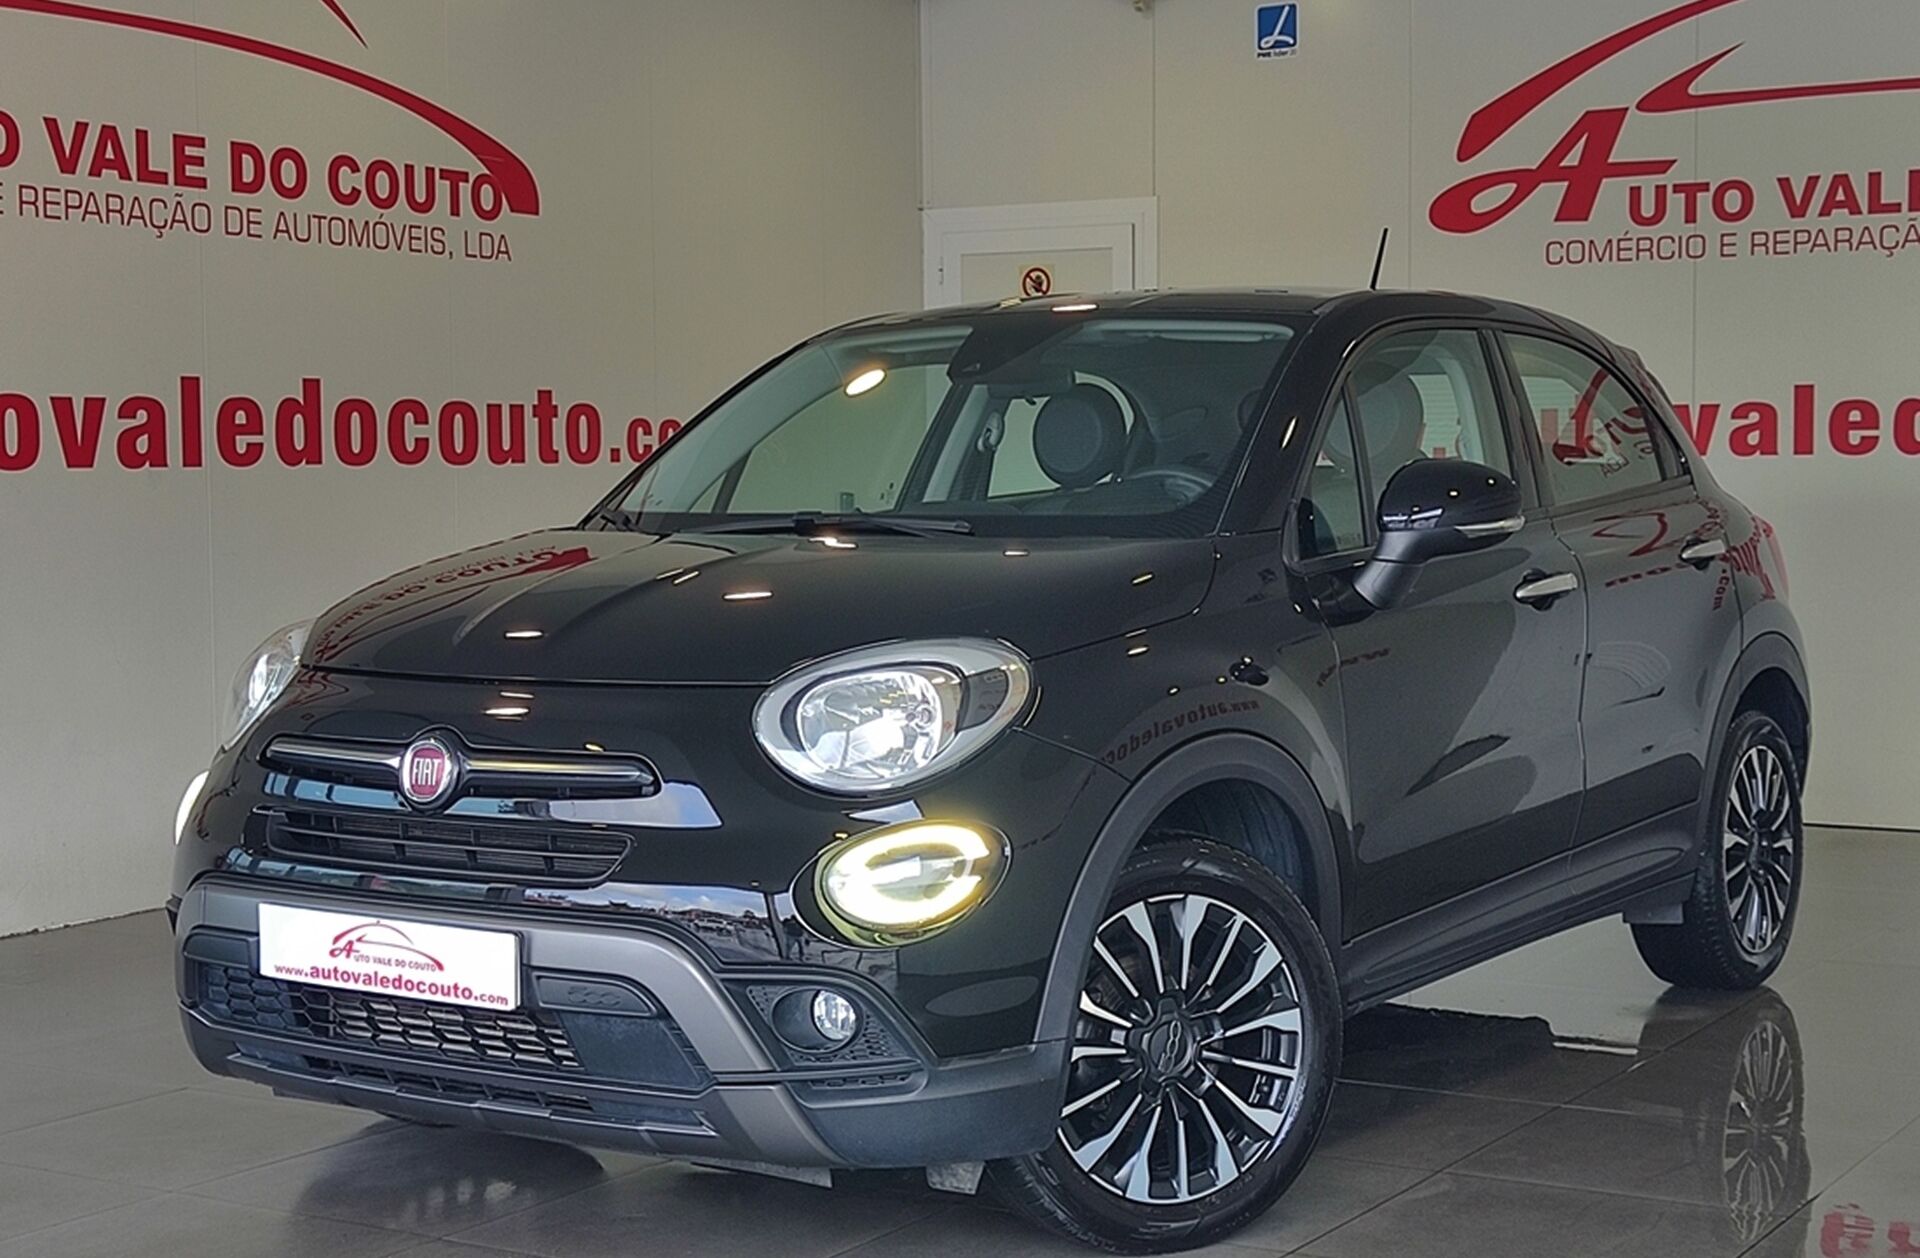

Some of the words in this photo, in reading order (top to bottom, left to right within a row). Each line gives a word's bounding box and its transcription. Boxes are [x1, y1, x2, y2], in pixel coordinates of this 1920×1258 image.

[43, 116, 208, 191] VALE
[230, 141, 308, 200] DO
[327, 154, 503, 222] COUTO
[18, 184, 212, 239] REPARAÇÃO
[225, 206, 263, 241] DE
[273, 211, 454, 260] AUTOMÓVEIS,
[464, 231, 512, 262] LDA
[1545, 231, 1706, 266] COMÉRCIO
[1720, 232, 1738, 258] E
[411, 756, 441, 787] FIAT
[372, 956, 393, 967] VALE
[395, 959, 407, 968] DO
[408, 960, 437, 972] COUTO
[274, 964, 509, 1007] www.autovaledocouto.com
